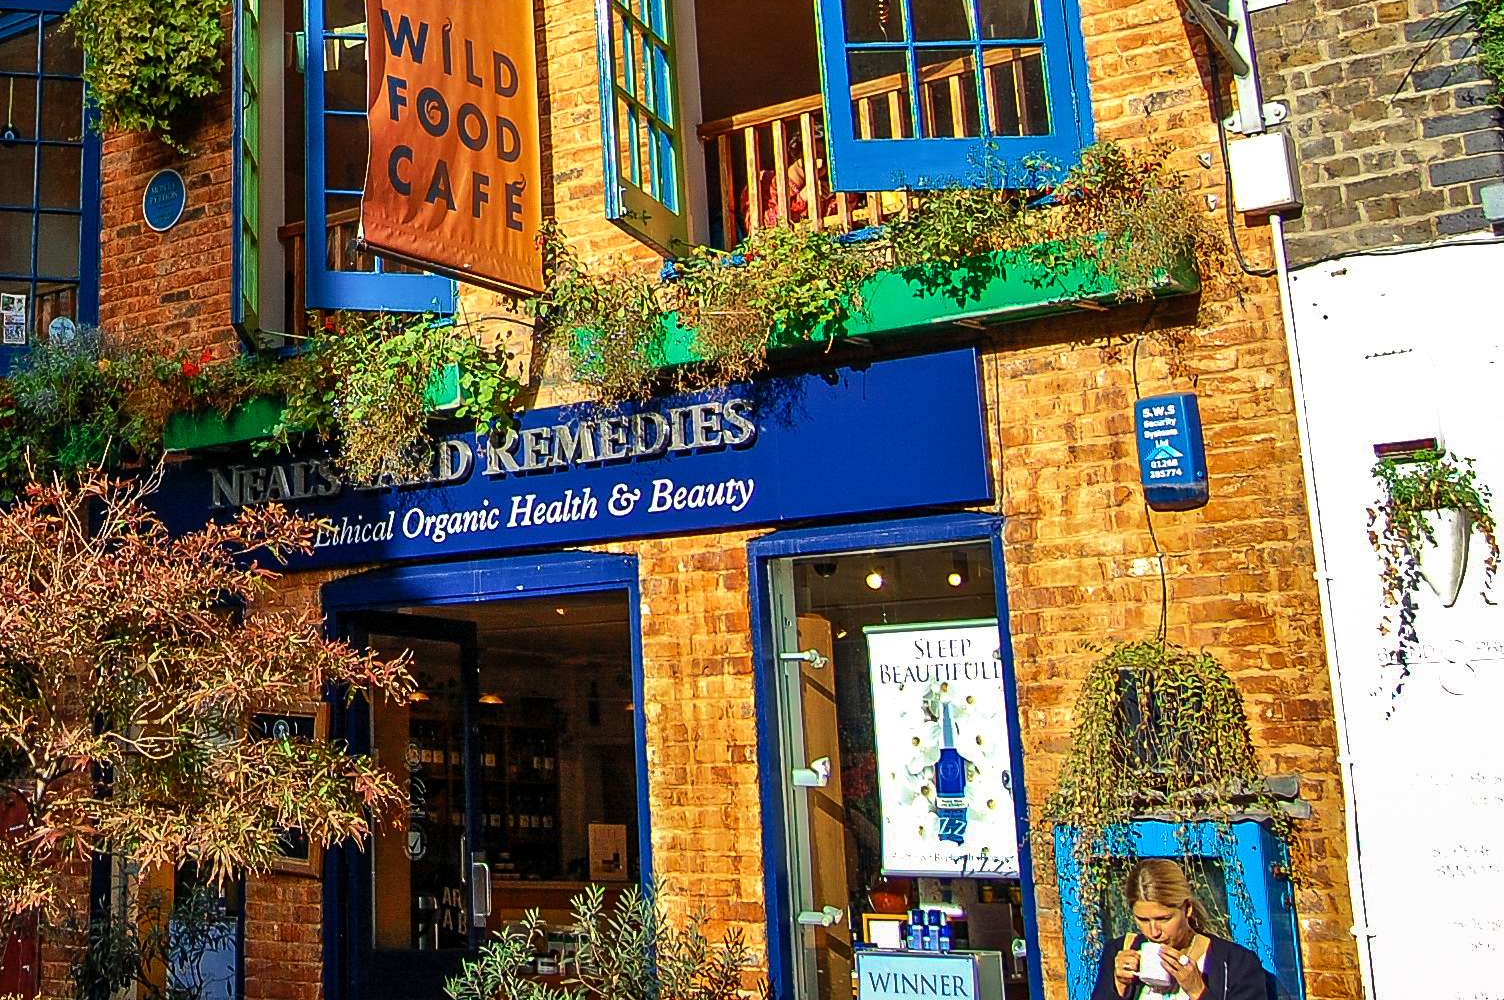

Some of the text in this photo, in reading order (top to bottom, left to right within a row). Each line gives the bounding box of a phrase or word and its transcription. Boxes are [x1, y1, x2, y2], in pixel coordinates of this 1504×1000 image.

[381, 9, 519, 98] WILD
[386, 74, 521, 162] FOOD
[388, 144, 527, 232] CAFÉ
[208, 458, 342, 509] NEAL'S
[481, 399, 757, 476] REMEDIES
[314, 478, 755, 548] Ethical Organic Health & Beauty
[879, 661, 1001, 684] BEAUTIFULL
[914, 637, 971, 659] SLEEP
[867, 971, 969, 997] WINNER
